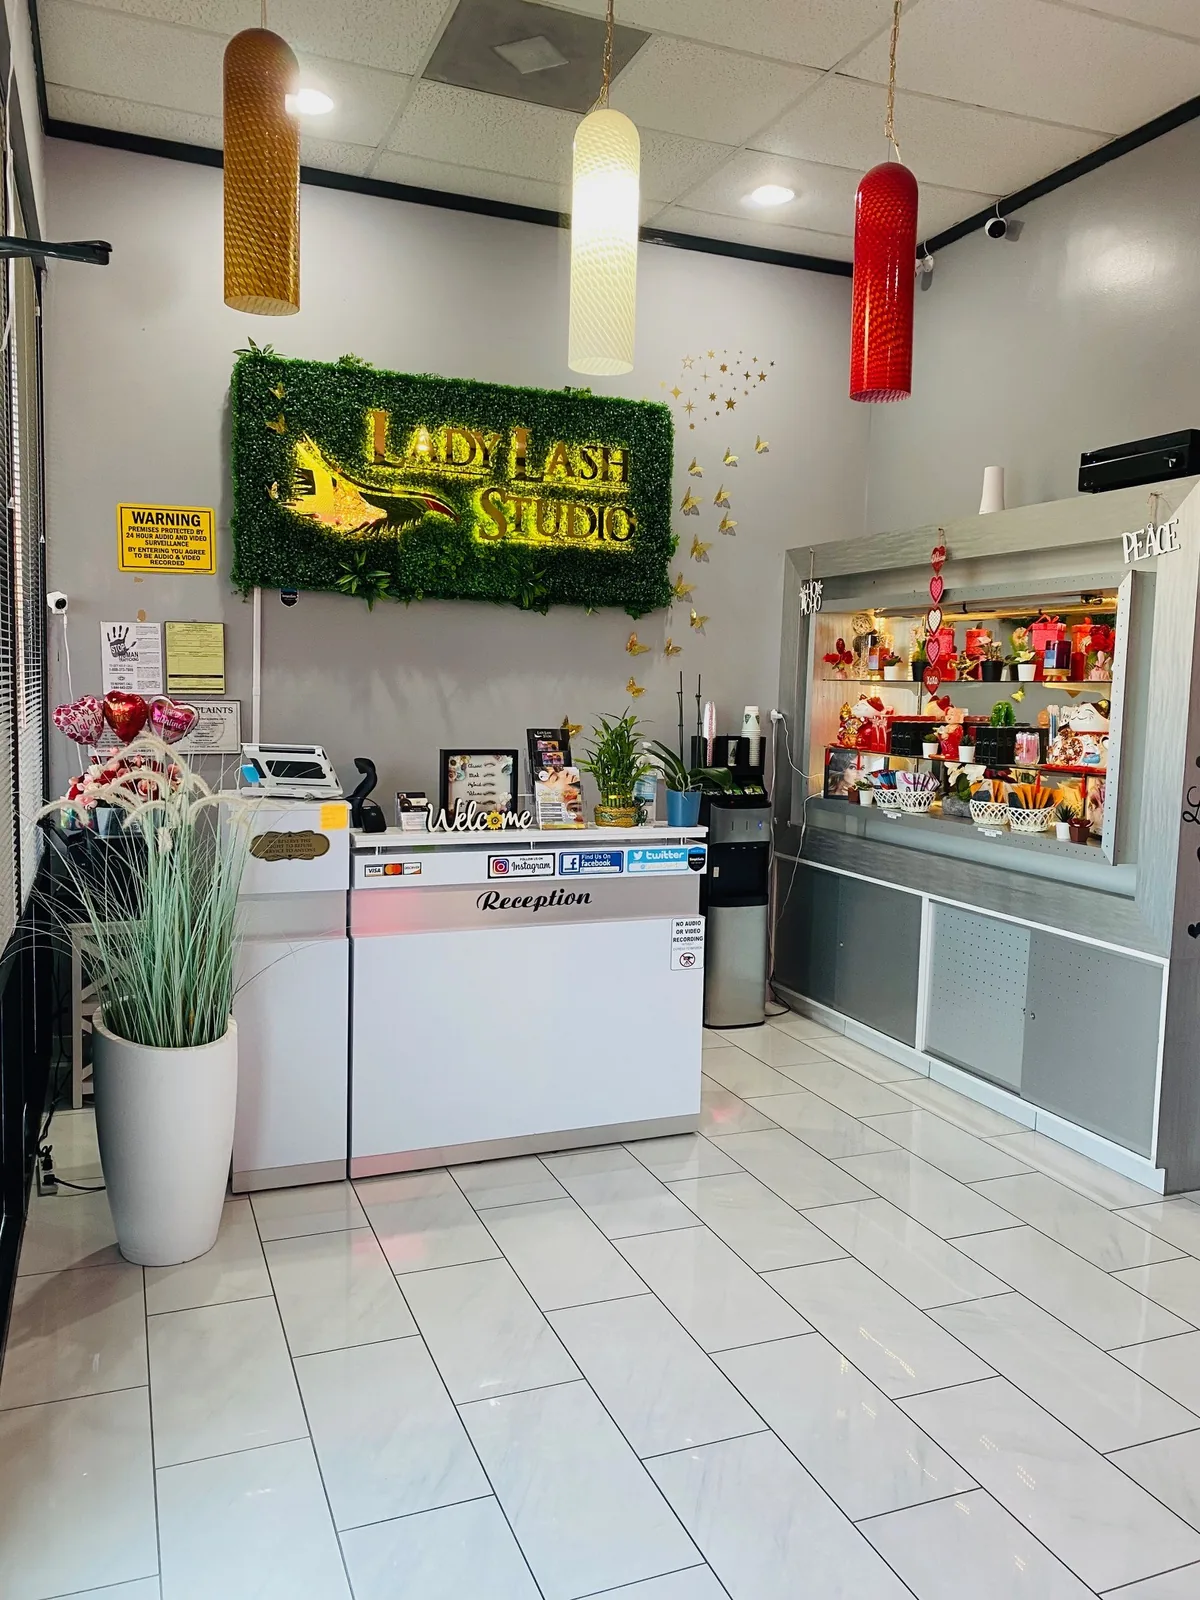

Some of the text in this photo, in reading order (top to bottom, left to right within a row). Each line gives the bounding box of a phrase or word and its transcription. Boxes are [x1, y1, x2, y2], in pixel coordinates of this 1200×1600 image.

[371, 409, 630, 483] LADY LASH
[131, 511, 201, 527] WARNING
[478, 486, 637, 542] STUDIO
[161, 527, 194, 535] PROTECTED
[1121, 519, 1181, 564] PEACE
[110, 643, 126, 654] STOP
[197, 706, 234, 715] PLAINTS
[645, 850, 685, 860] twitter
[511, 861, 551, 873] Instagram
[581, 859, 611, 867] facebook
[476, 888, 593, 912] Reception
